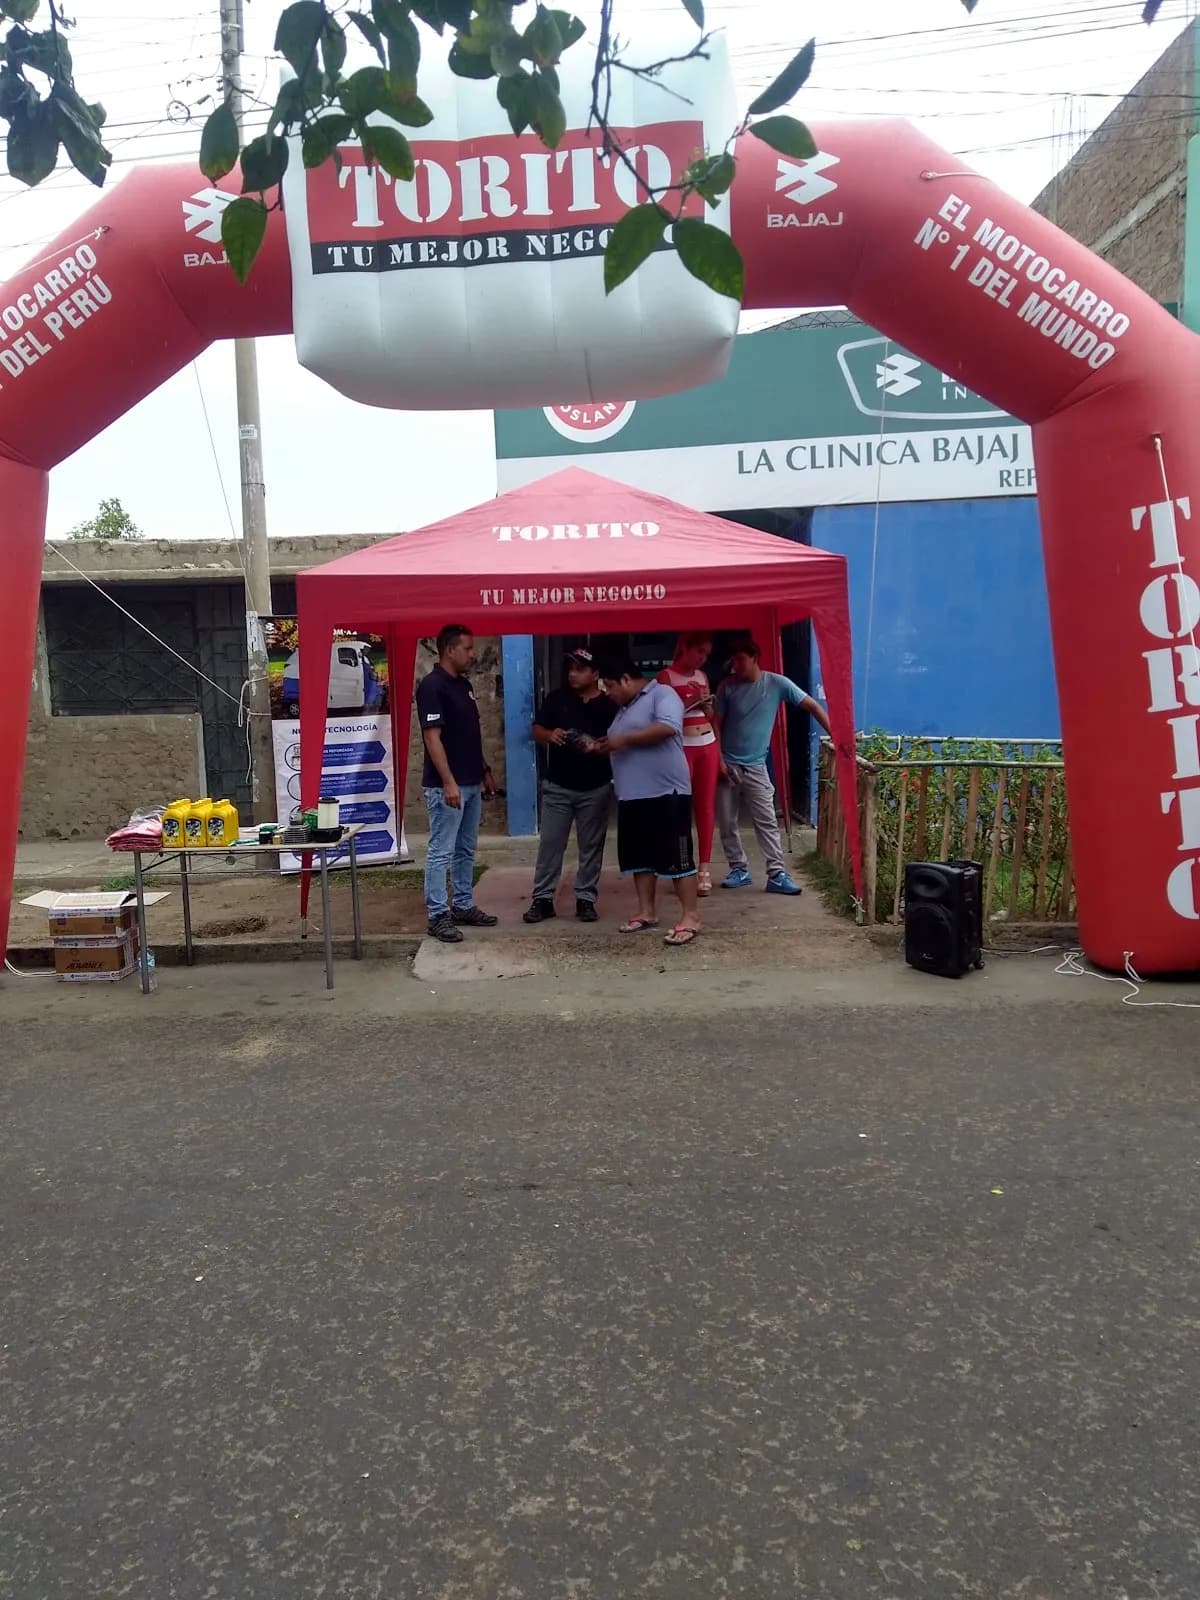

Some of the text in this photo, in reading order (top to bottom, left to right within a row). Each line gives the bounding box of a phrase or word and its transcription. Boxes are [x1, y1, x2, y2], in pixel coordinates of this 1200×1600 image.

[339, 144, 672, 227] TORITO
[767, 212, 844, 228] BAJAJ
[184, 252, 231, 268] BAJ
[327, 223, 675, 268] TU MEJOR NEGOO
[938, 194, 1131, 339] EL MOTOCARRO
[0, 270, 113, 378] DEL PERÚ
[949, 244, 970, 271] 1
[968, 256, 1020, 309] DEL
[1017, 292, 1116, 370] MUNDO
[737, 433, 1019, 476] LA CLINICA BAJAJ
[492, 521, 661, 542] TORITO
[480, 583, 667, 605] TU MEJOR NEGOCIO
